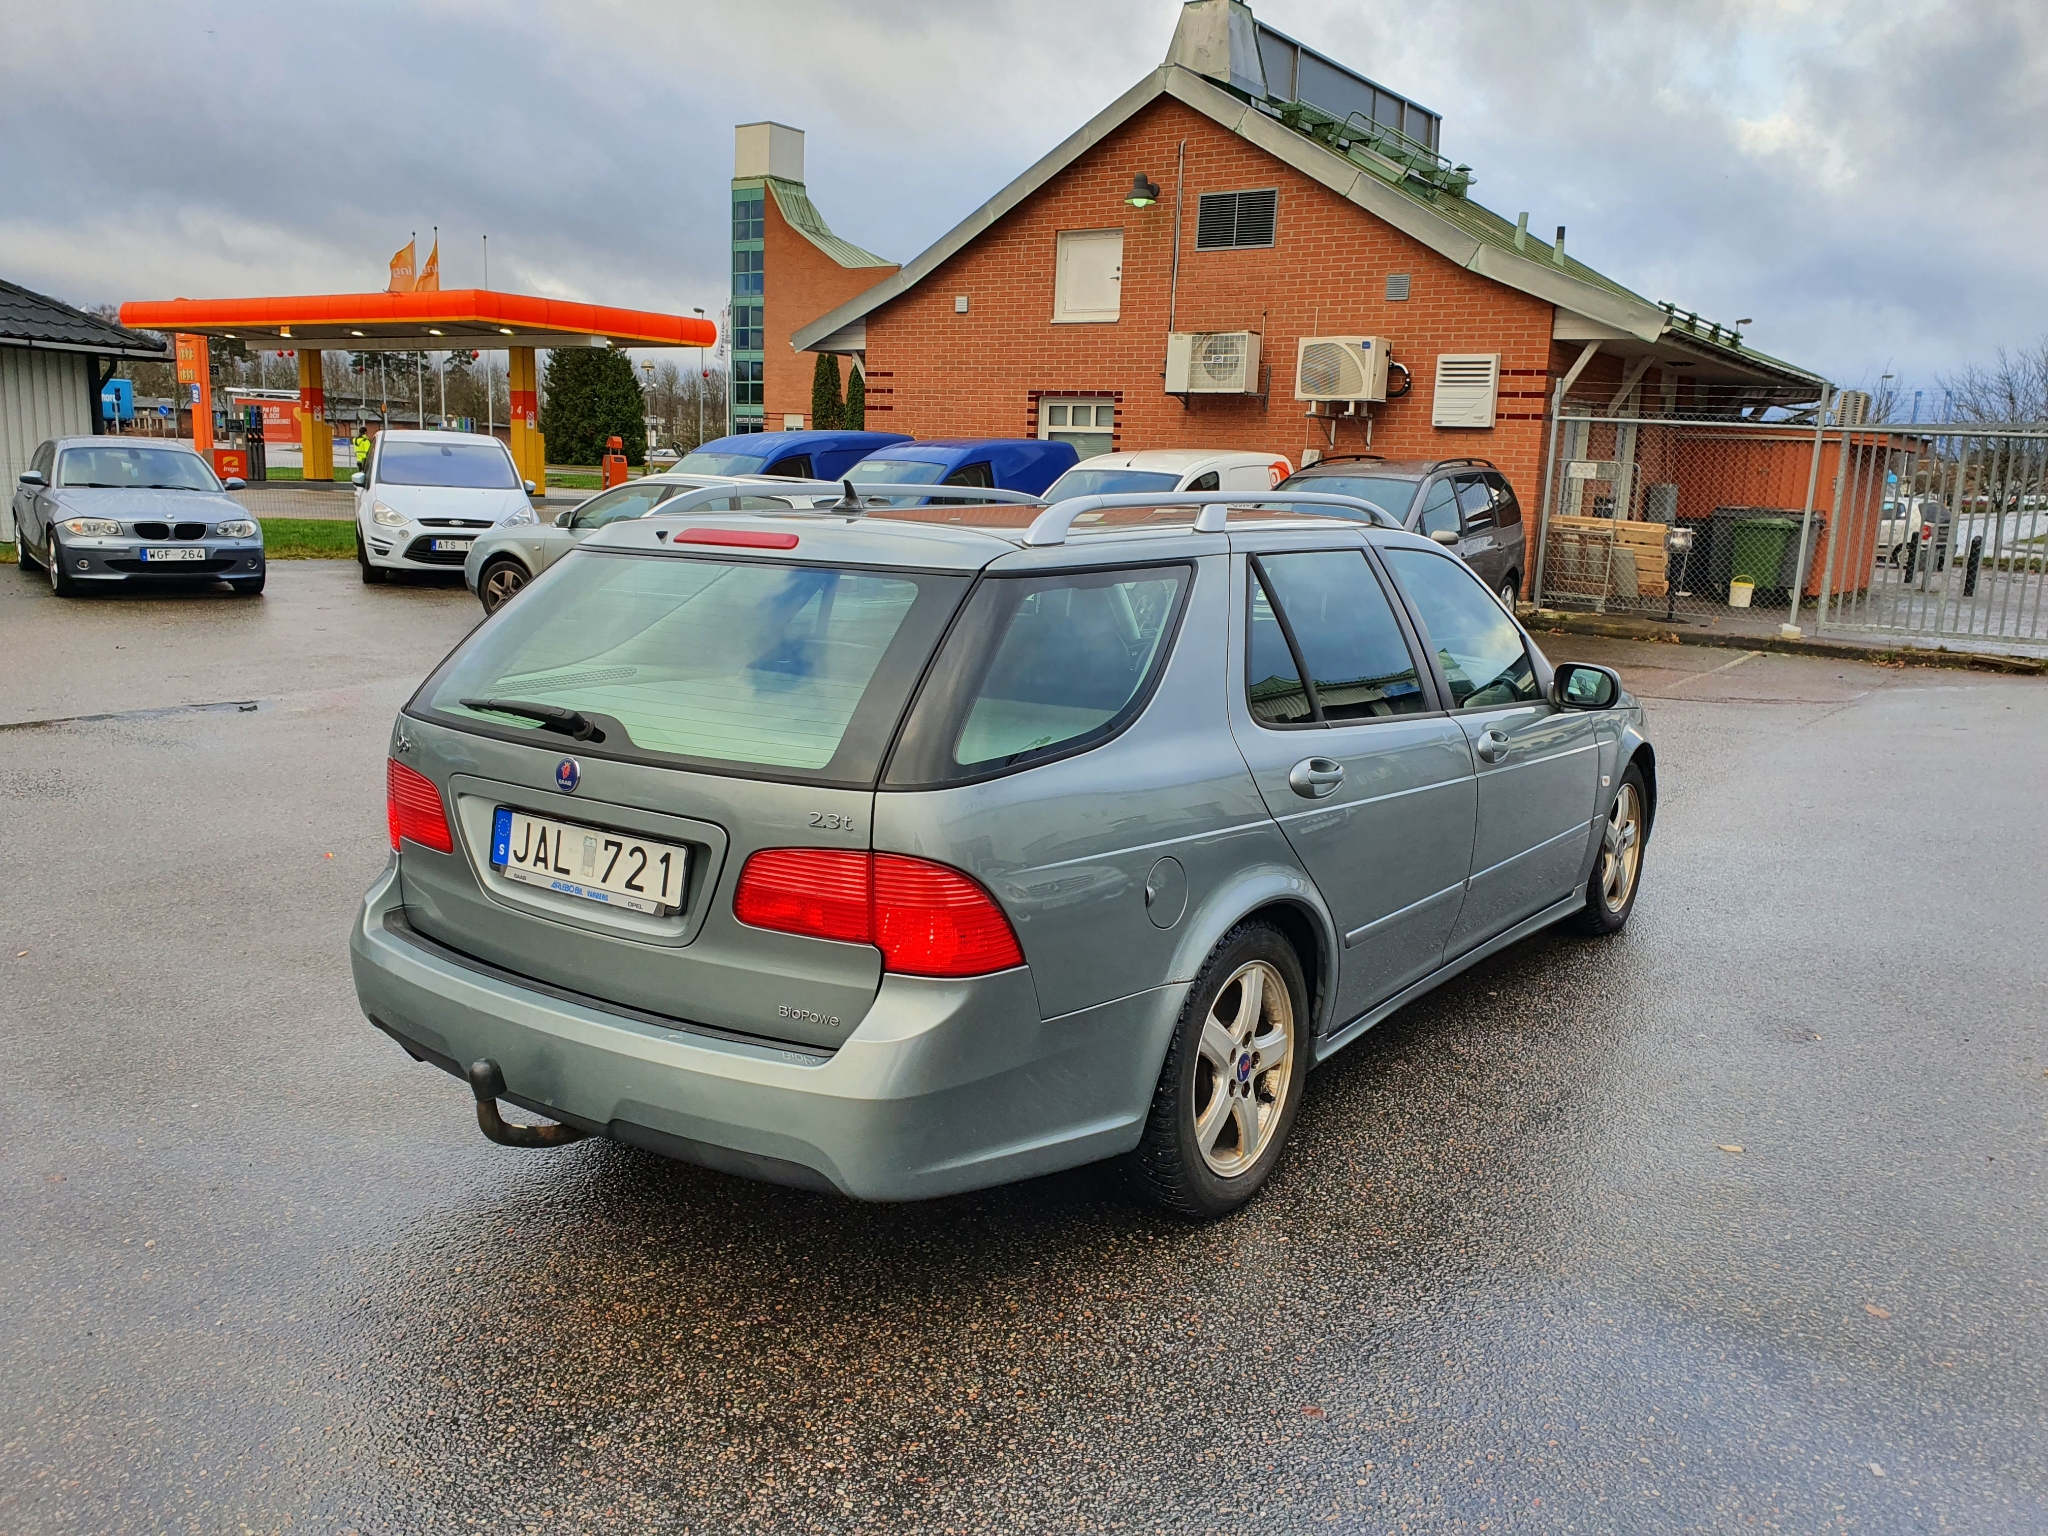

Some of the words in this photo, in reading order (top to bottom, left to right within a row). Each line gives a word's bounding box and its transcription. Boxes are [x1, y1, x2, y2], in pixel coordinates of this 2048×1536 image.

[516, 405, 522, 415] 4
[223, 465, 239, 474] Ingo
[438, 541, 456, 550] ATS
[464, 541, 474, 550] 1
[148, 549, 171, 560] WGF
[181, 549, 203, 560] 264
[808, 811, 854, 831] 2.3t
[498, 844, 505, 855] S
[513, 822, 571, 876] JAL
[600, 839, 672, 898] 721
[627, 901, 644, 910] OPEL
[778, 1004, 840, 1027] BioPowe
